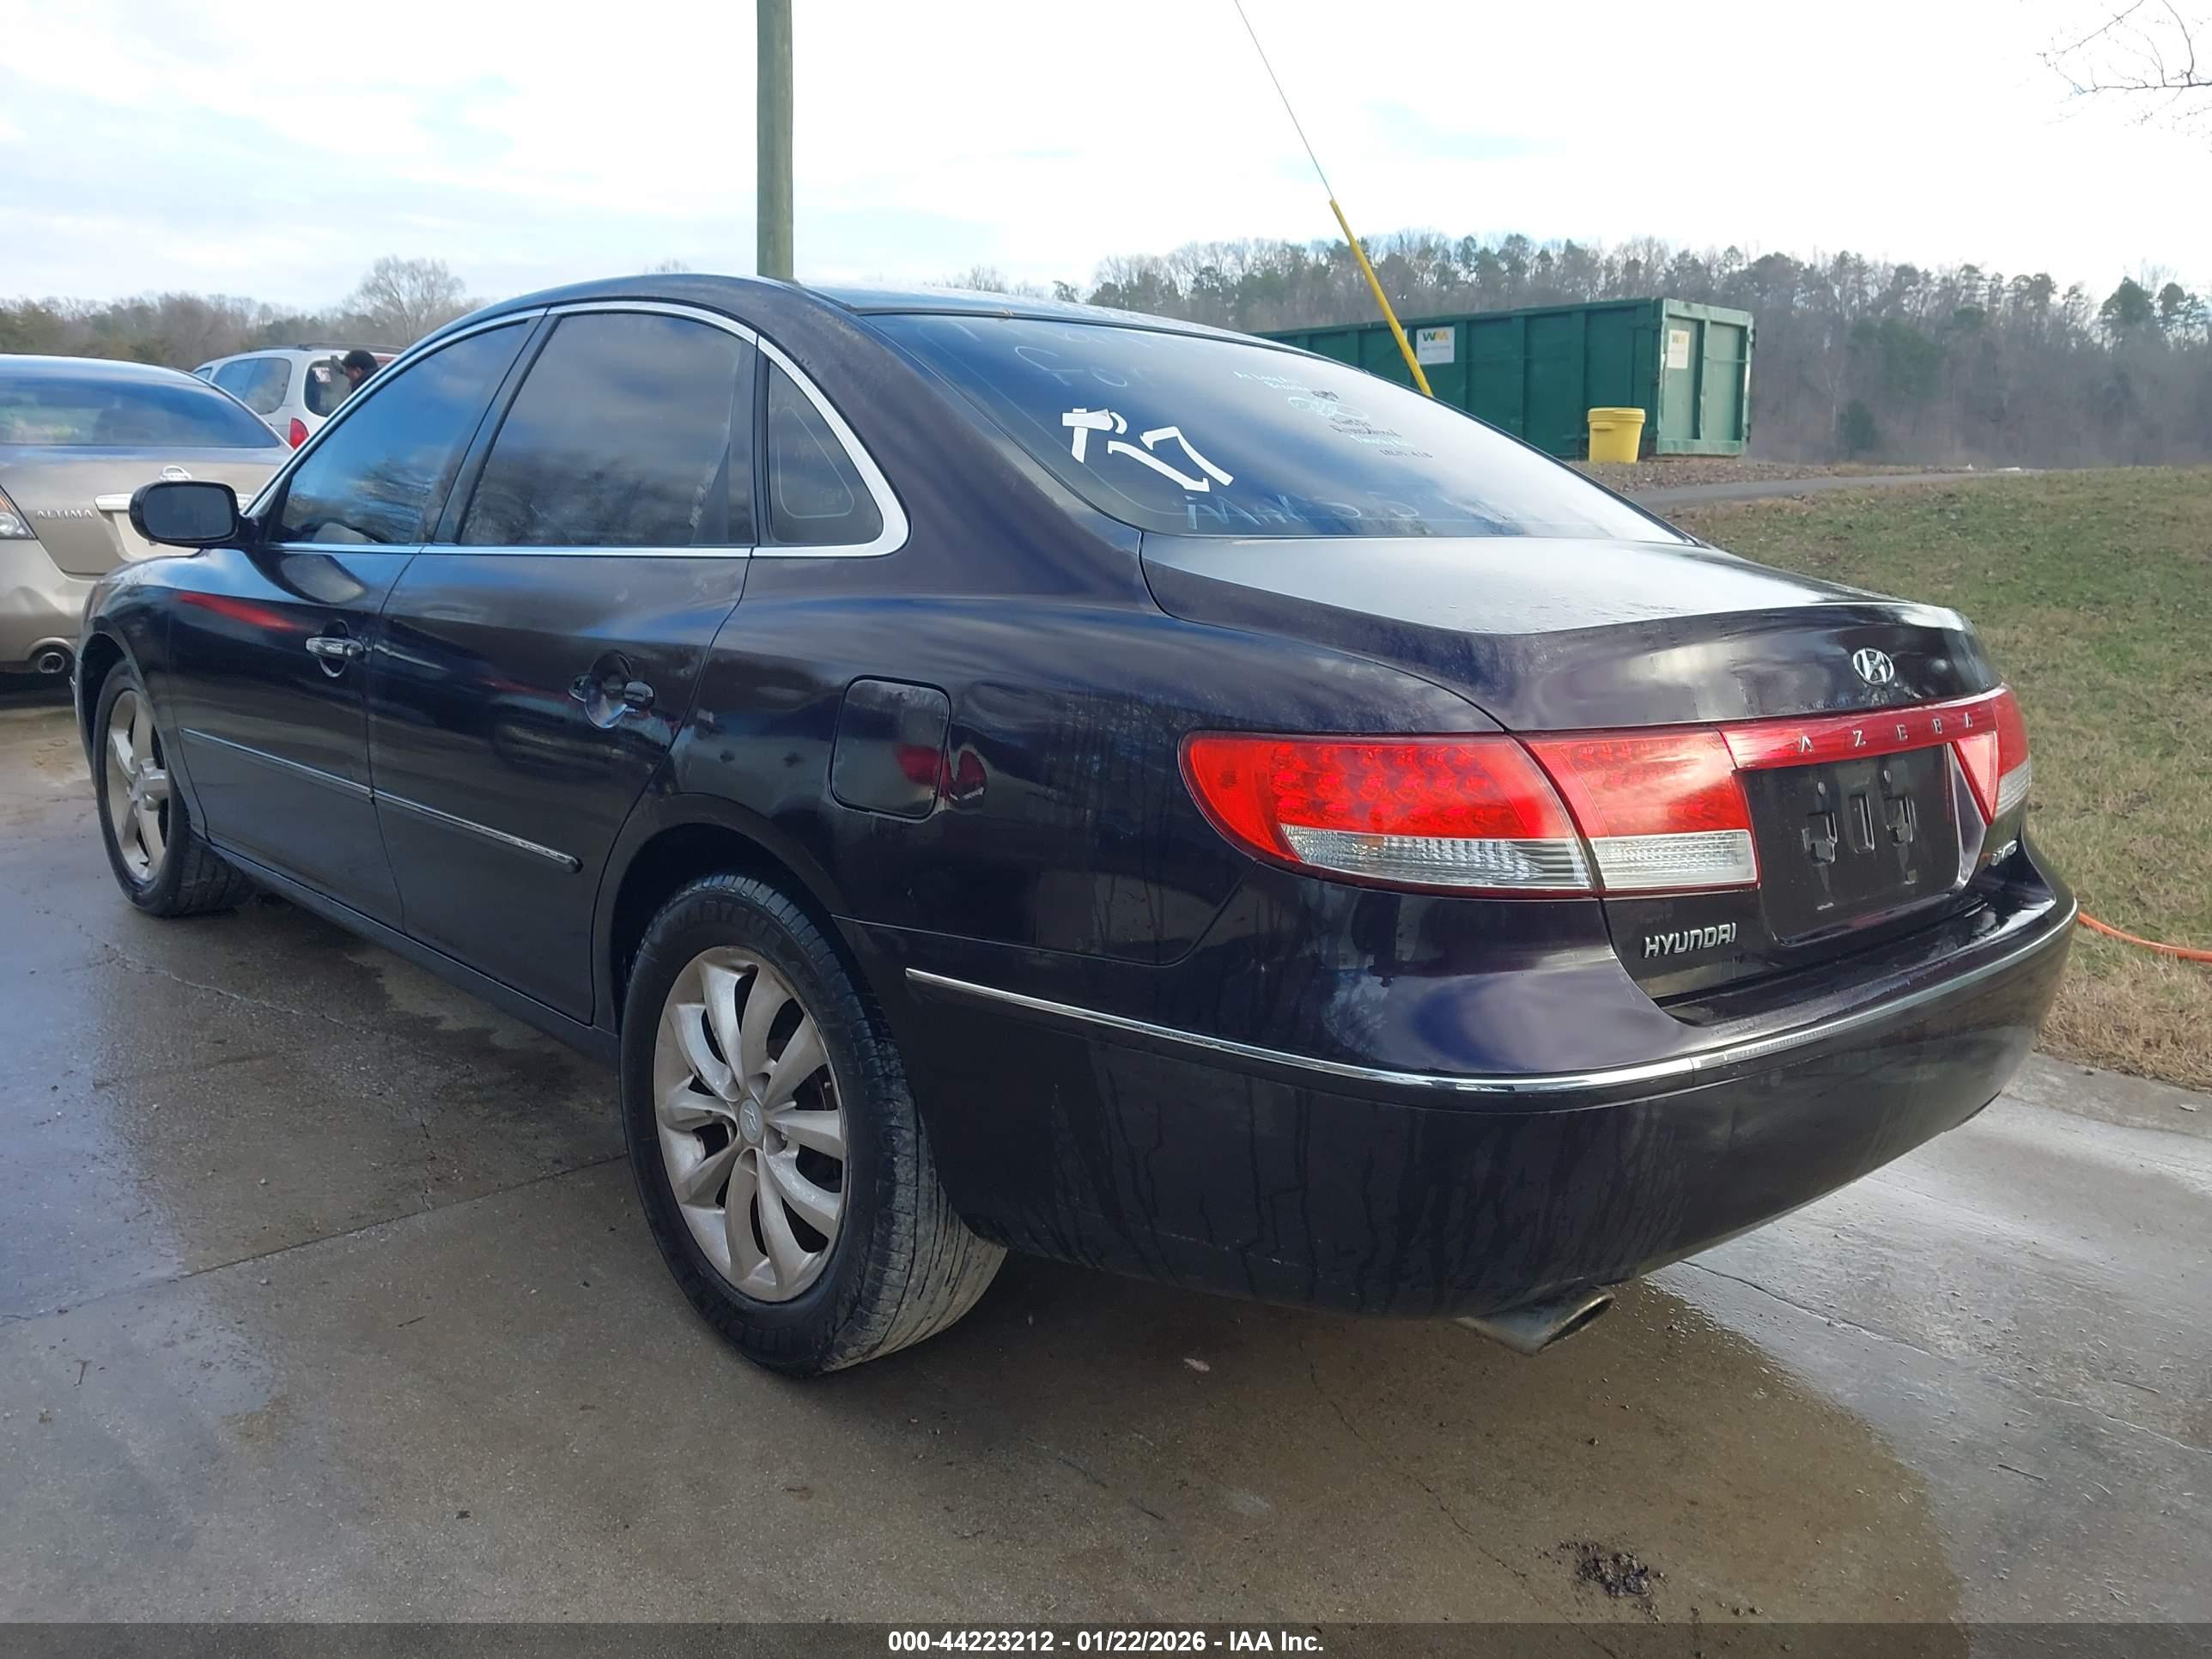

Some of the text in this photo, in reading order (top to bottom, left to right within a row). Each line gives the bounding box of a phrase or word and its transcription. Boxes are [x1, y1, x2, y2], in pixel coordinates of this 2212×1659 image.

[36, 508, 94, 520] ALTIMA
[1800, 711, 1974, 754] AZERA
[1644, 921, 1737, 959] HYUNDAI
